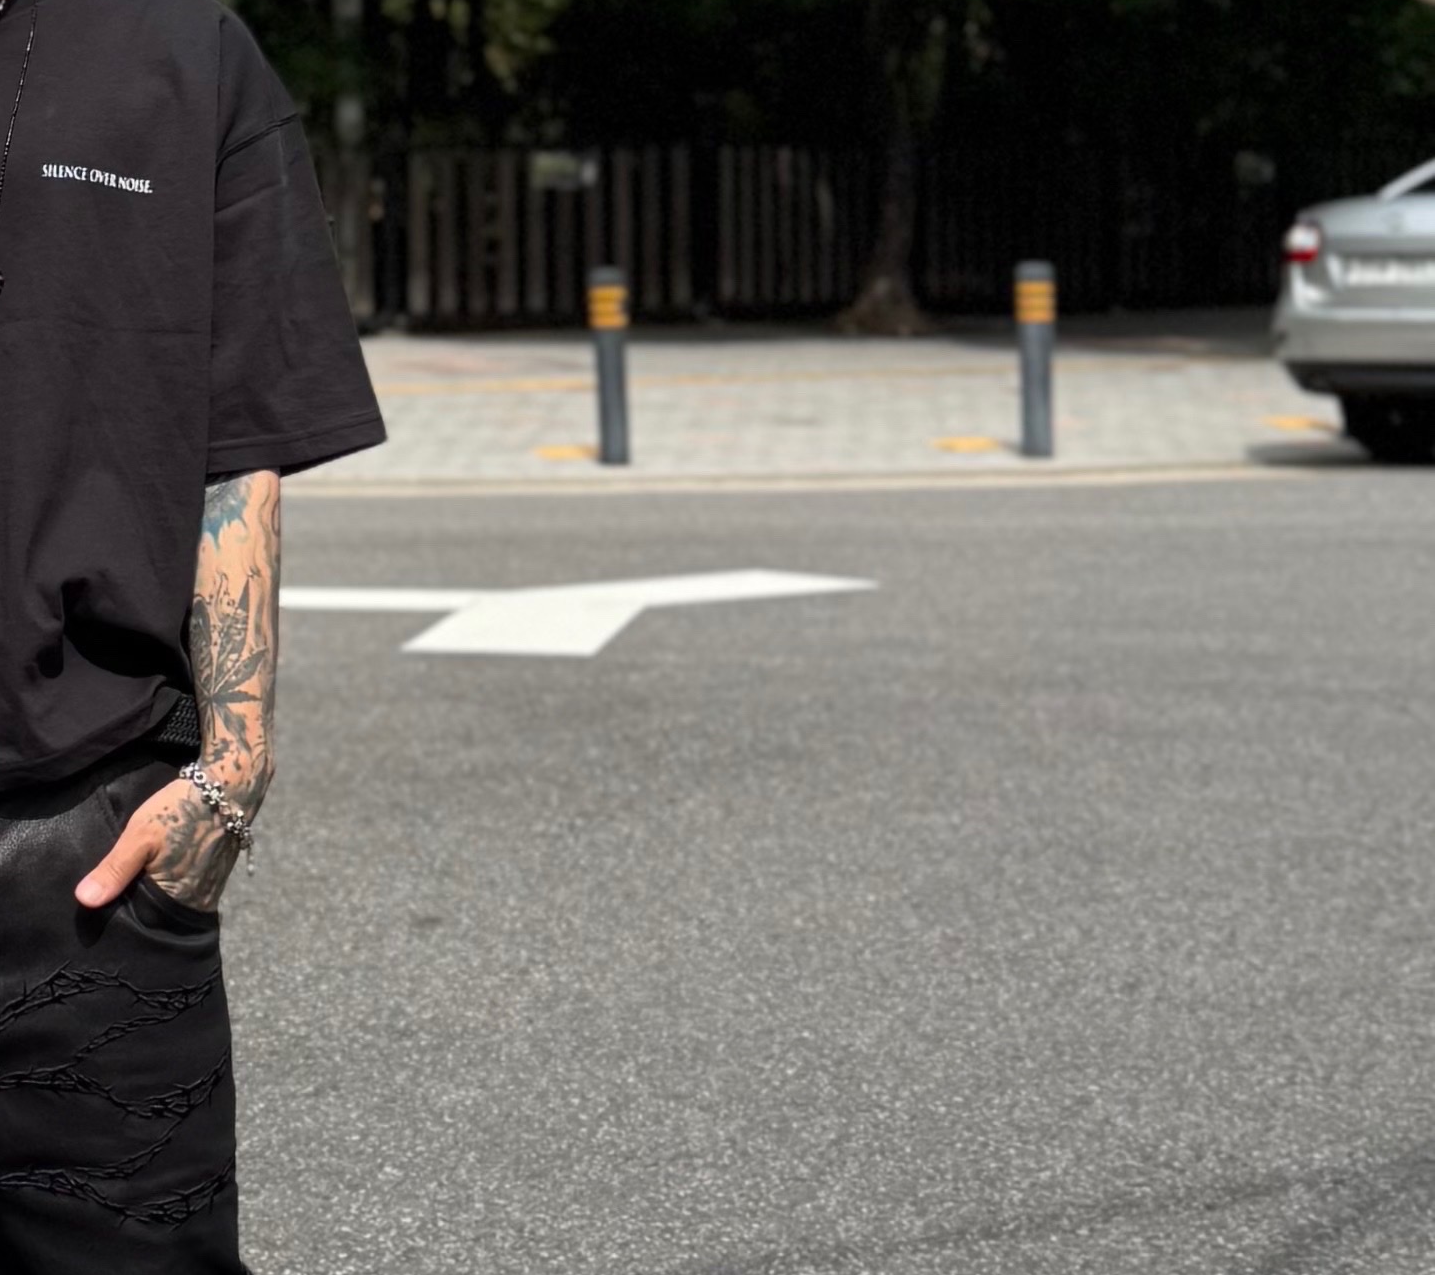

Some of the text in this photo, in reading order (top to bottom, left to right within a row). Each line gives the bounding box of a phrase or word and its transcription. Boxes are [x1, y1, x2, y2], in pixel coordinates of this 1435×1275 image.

[41, 163, 153, 194] SILENCE OVER NOISE.
